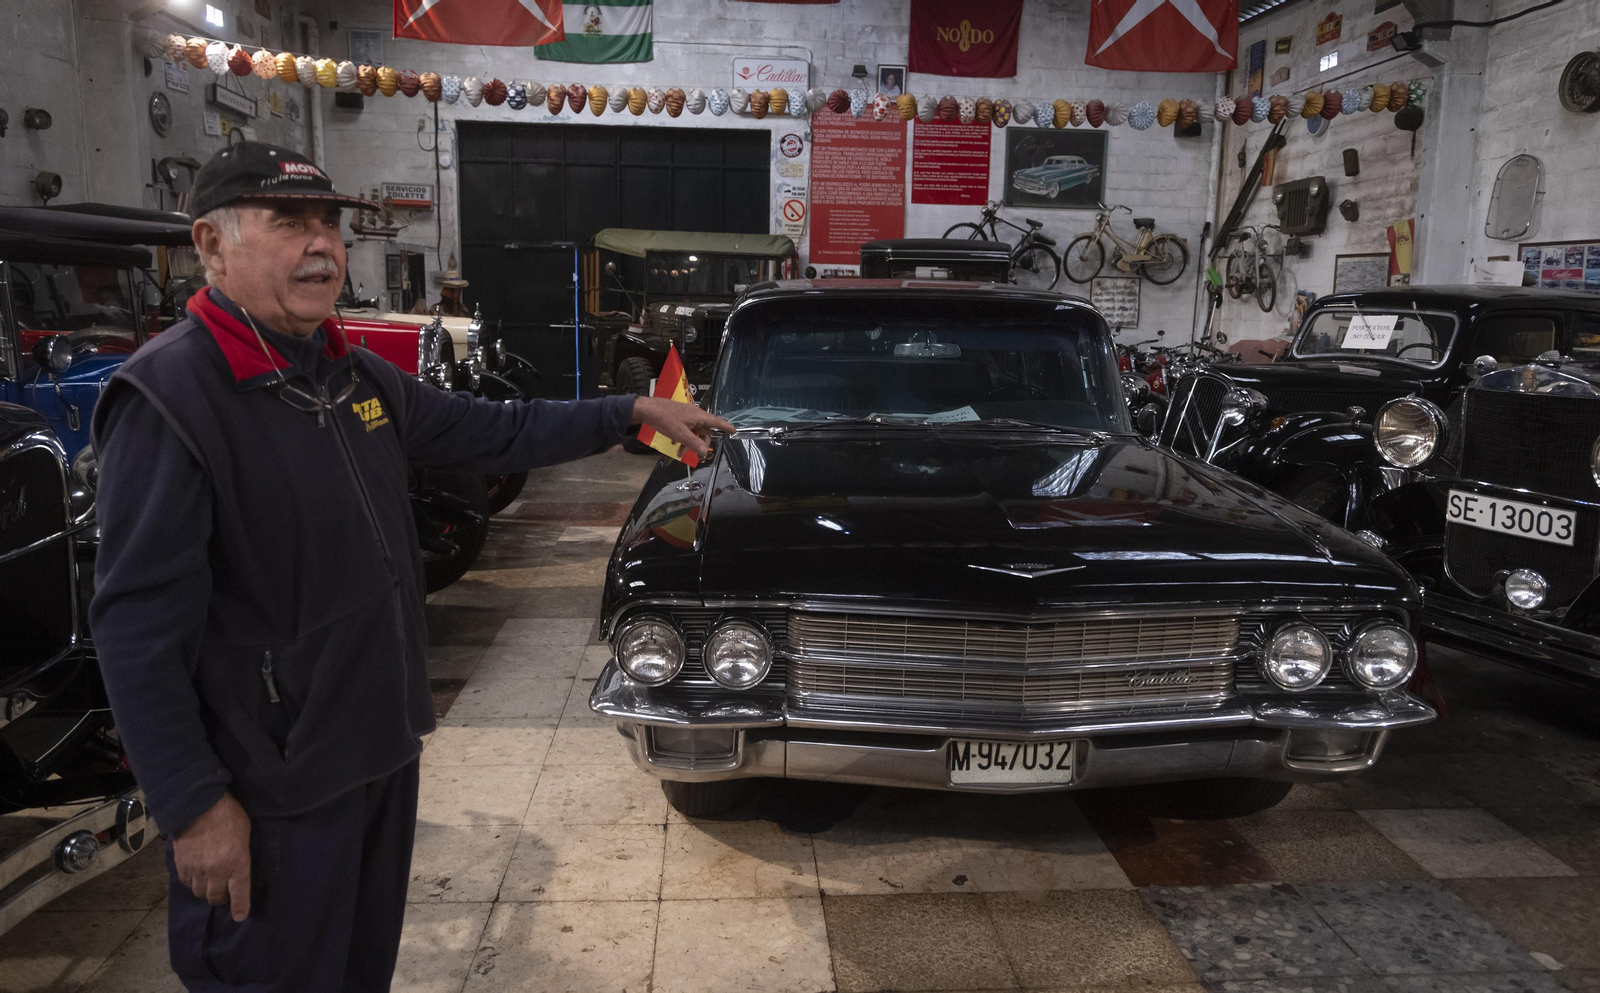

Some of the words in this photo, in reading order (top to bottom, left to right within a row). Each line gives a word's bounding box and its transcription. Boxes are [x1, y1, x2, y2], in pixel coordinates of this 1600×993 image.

[756, 64, 806, 83] Cadillac
[261, 174, 288, 188] fluid
[1126, 668, 1198, 688] Cadillac
